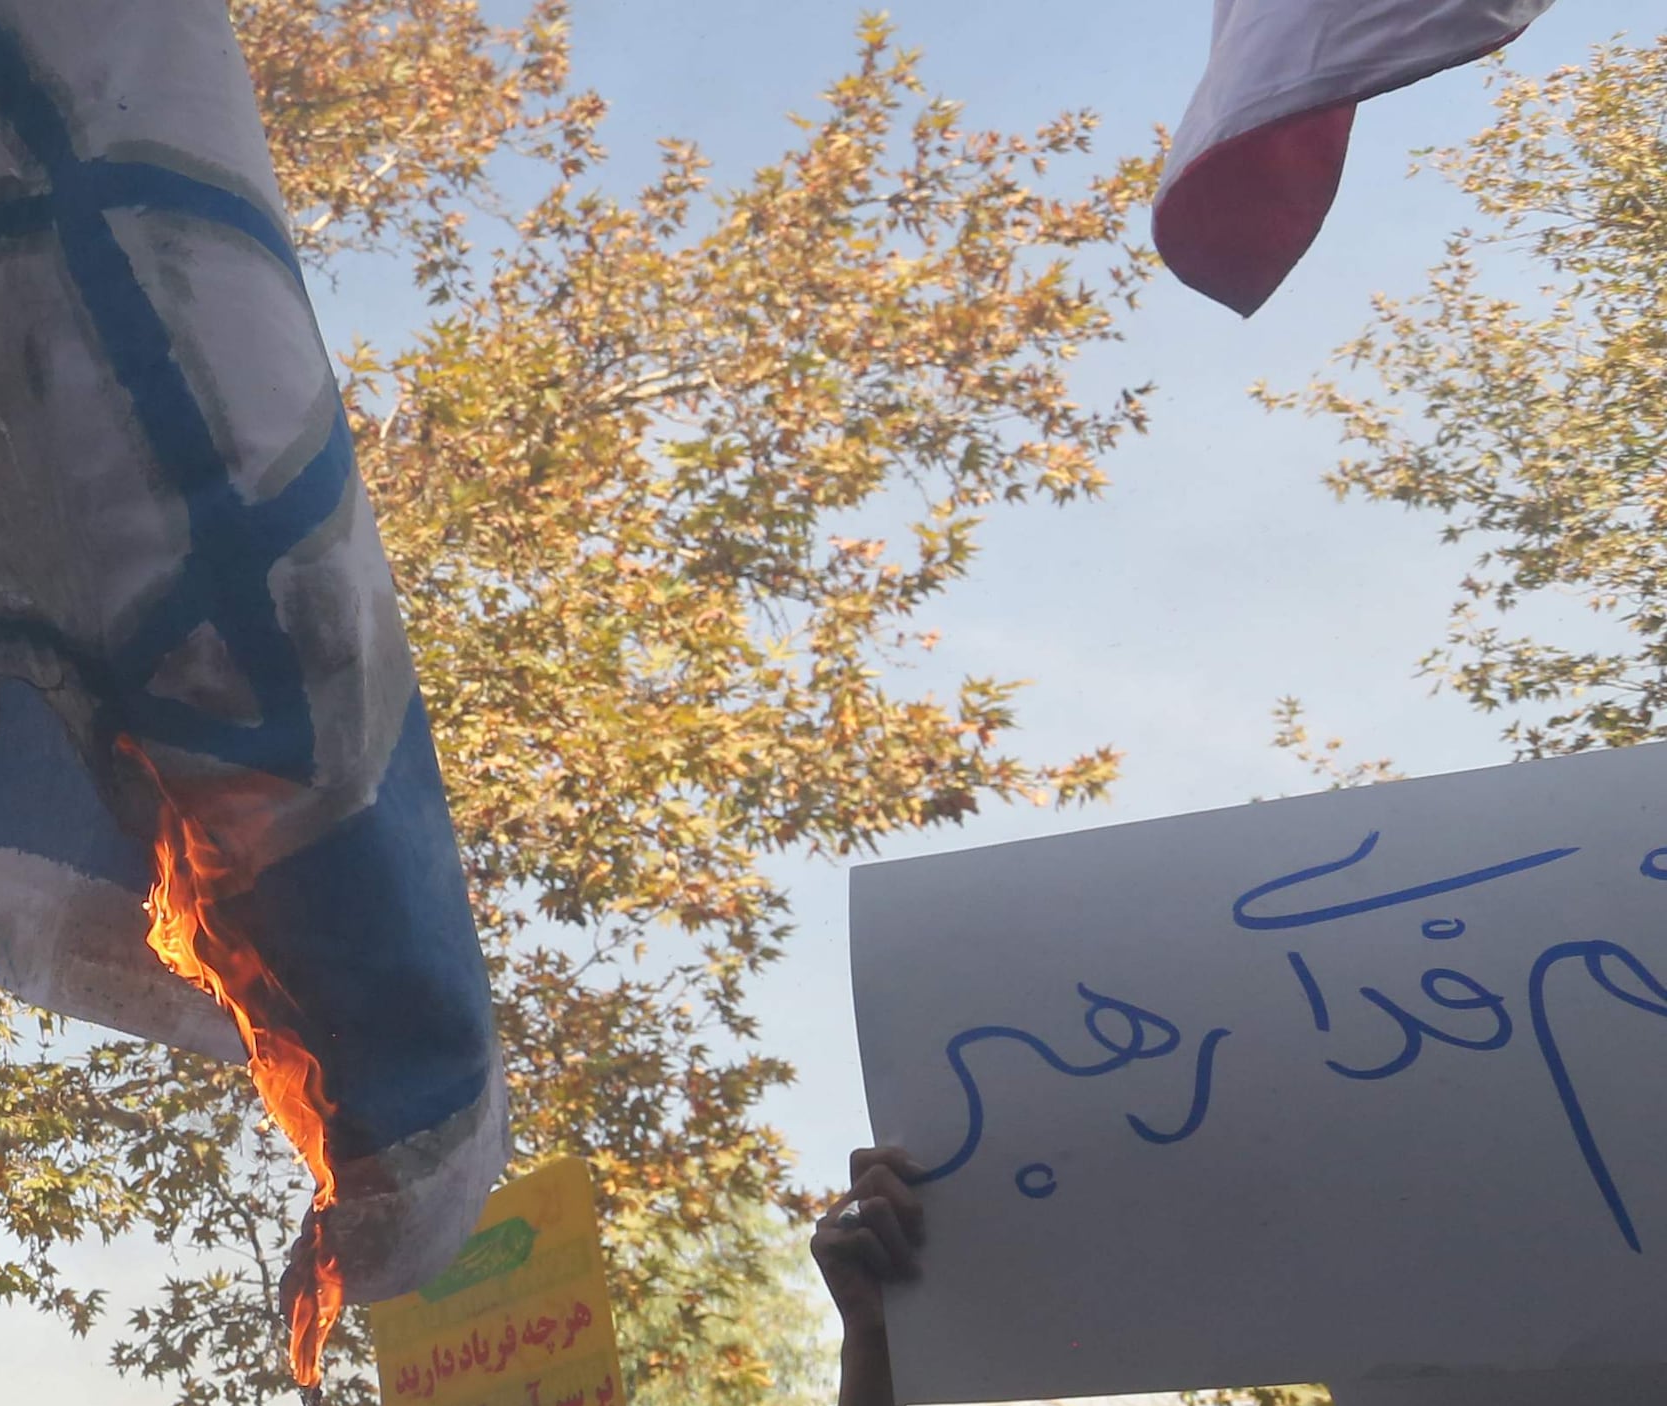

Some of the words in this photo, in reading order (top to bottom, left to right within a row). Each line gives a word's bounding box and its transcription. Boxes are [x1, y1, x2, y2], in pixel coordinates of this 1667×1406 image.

[907, 981, 1233, 1199] رهبر
[395, 1343, 456, 1398] دارید
[458, 1313, 518, 1374] فریاد
